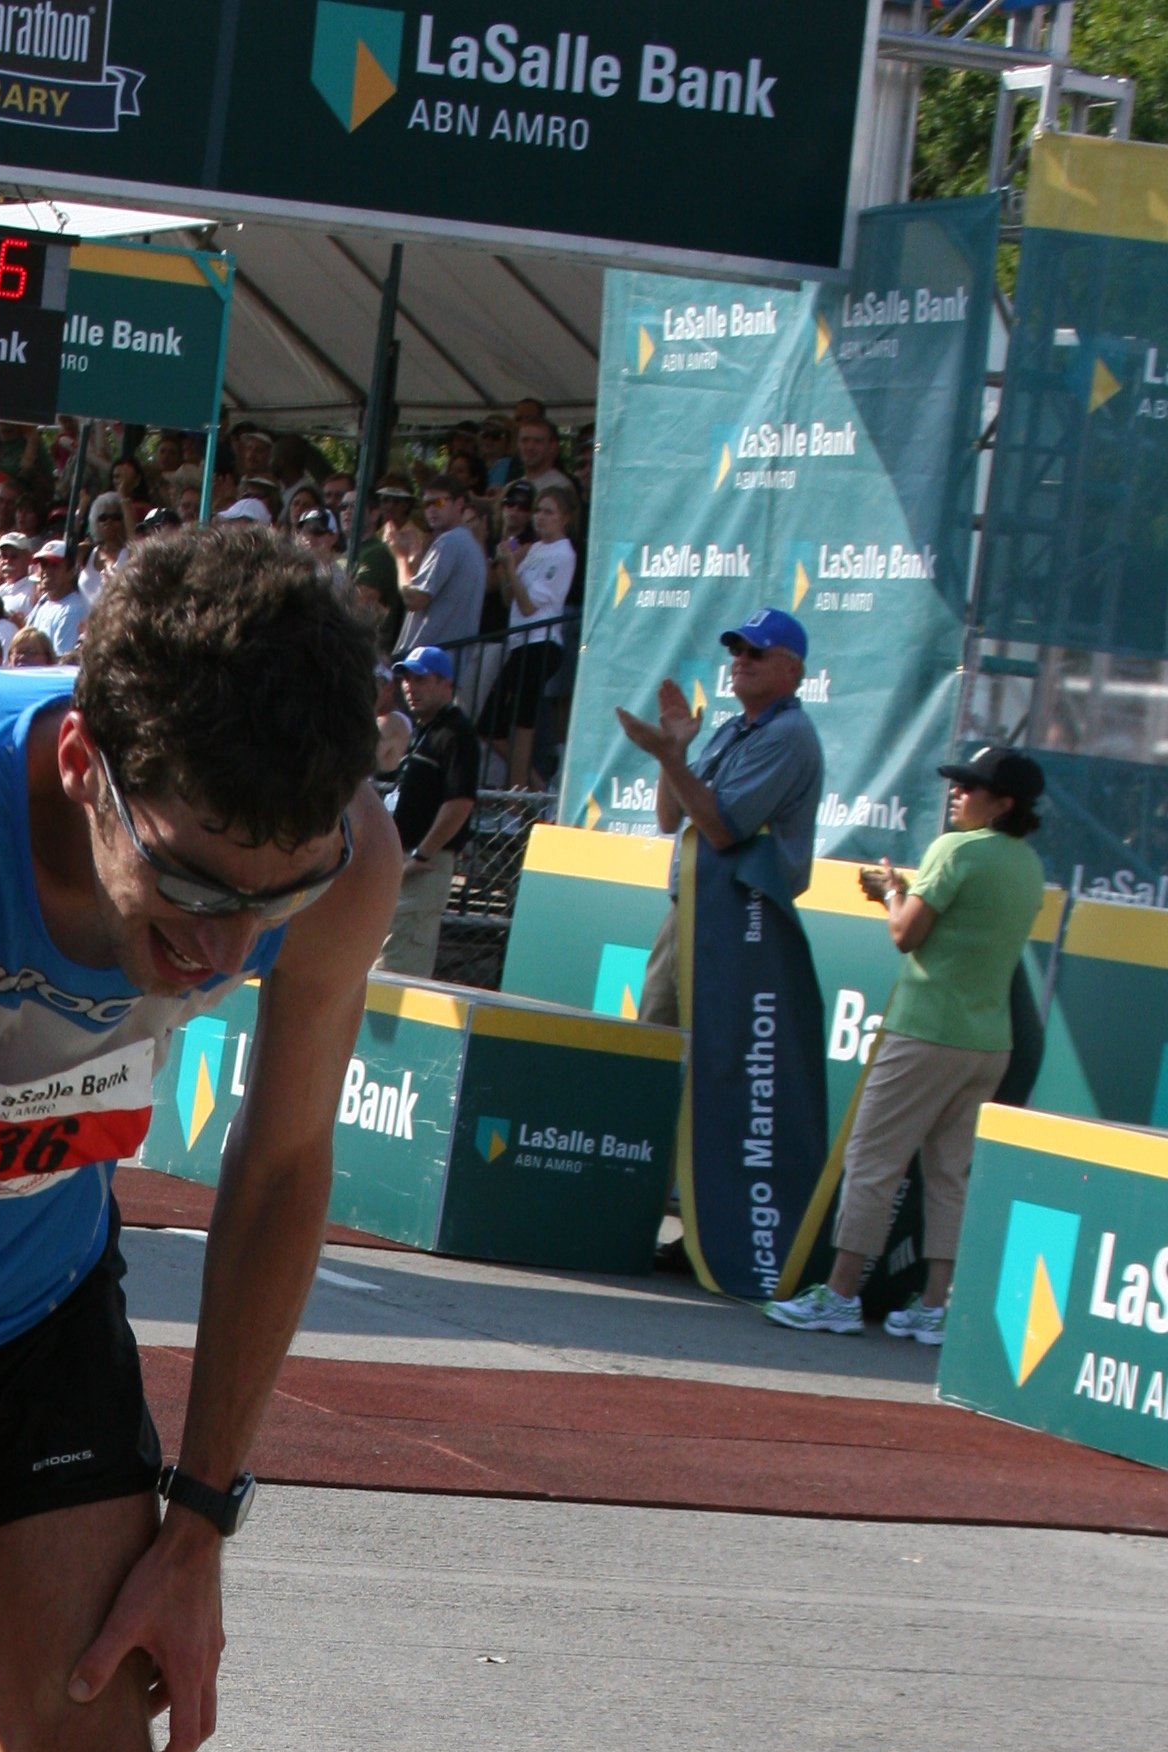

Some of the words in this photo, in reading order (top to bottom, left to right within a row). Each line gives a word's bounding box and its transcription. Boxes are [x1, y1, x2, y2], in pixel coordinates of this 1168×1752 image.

[415, 13, 622, 98] LaSalle
[638, 43, 778, 119] Bank
[407, 98, 480, 138] ABN
[489, 108, 591, 151] AMRO
[663, 304, 728, 341] LaSalle
[730, 299, 777, 337] Bank
[841, 289, 911, 328] LaSalle
[914, 286, 969, 323] Bank
[112, 319, 183, 356] Bank
[736, 423, 806, 459] LaSalle
[809, 420, 857, 456] Bank
[639, 544, 702, 578] LaSalle
[702, 543, 751, 578] Bank
[818, 544, 886, 580] LaSalle
[887, 544, 938, 580] Bank
[81, 1064, 130, 1097] Bank
[338, 1057, 420, 1141] Bank
[743, 991, 775, 1168] Marathon
[518, 1123, 596, 1155] LaSalle
[600, 1136, 653, 1163] Bank
[514, 1153, 542, 1170] ABN
[544, 1156, 583, 1175] AMRO
[1073, 1351, 1139, 1411] ABN
